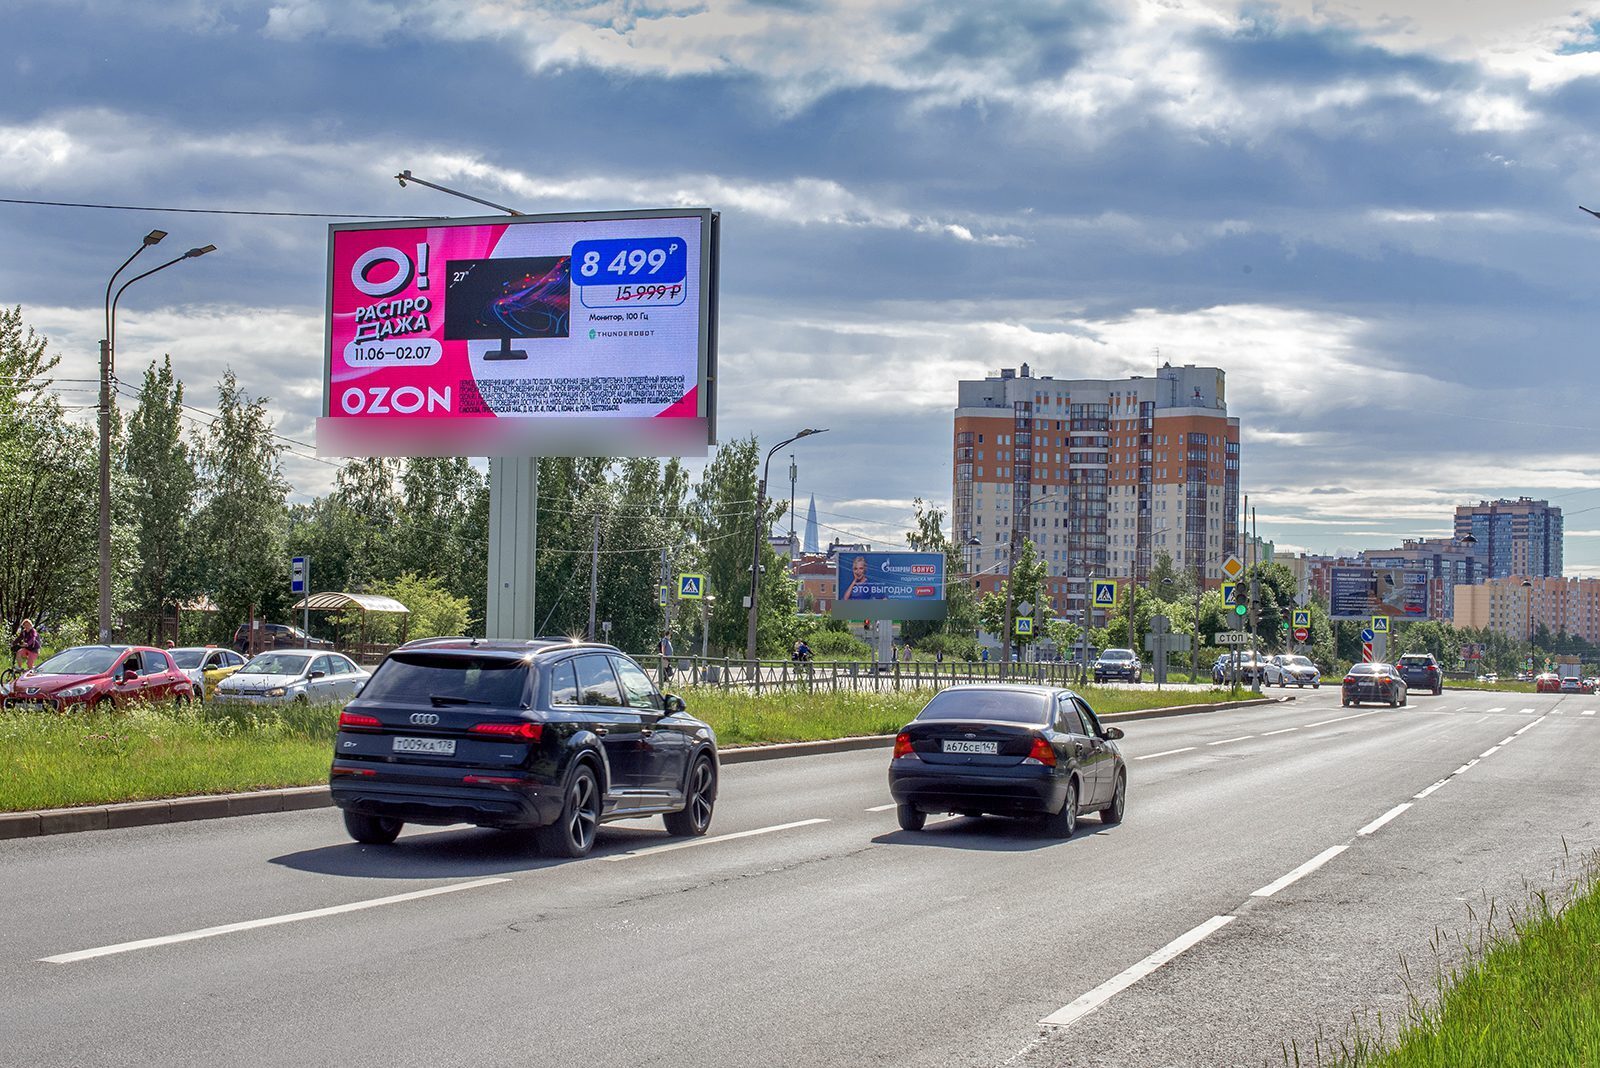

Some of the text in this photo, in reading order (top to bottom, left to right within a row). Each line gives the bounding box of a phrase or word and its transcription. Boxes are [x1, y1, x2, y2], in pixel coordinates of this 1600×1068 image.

[351, 242, 429, 297] О!
[581, 250, 600, 277] 8
[607, 248, 667, 276] 499
[617, 286, 632, 301] 15
[637, 284, 666, 300] 999
[355, 296, 430, 322] РАСПРО
[589, 312, 649, 322] Монитор, 100 Гц
[354, 315, 430, 343] ДАЖА
[341, 386, 451, 414] OZON
[853, 585, 913, 595] ЭТО ВЫГОДНО
[1220, 633, 1244, 642] СТОП
